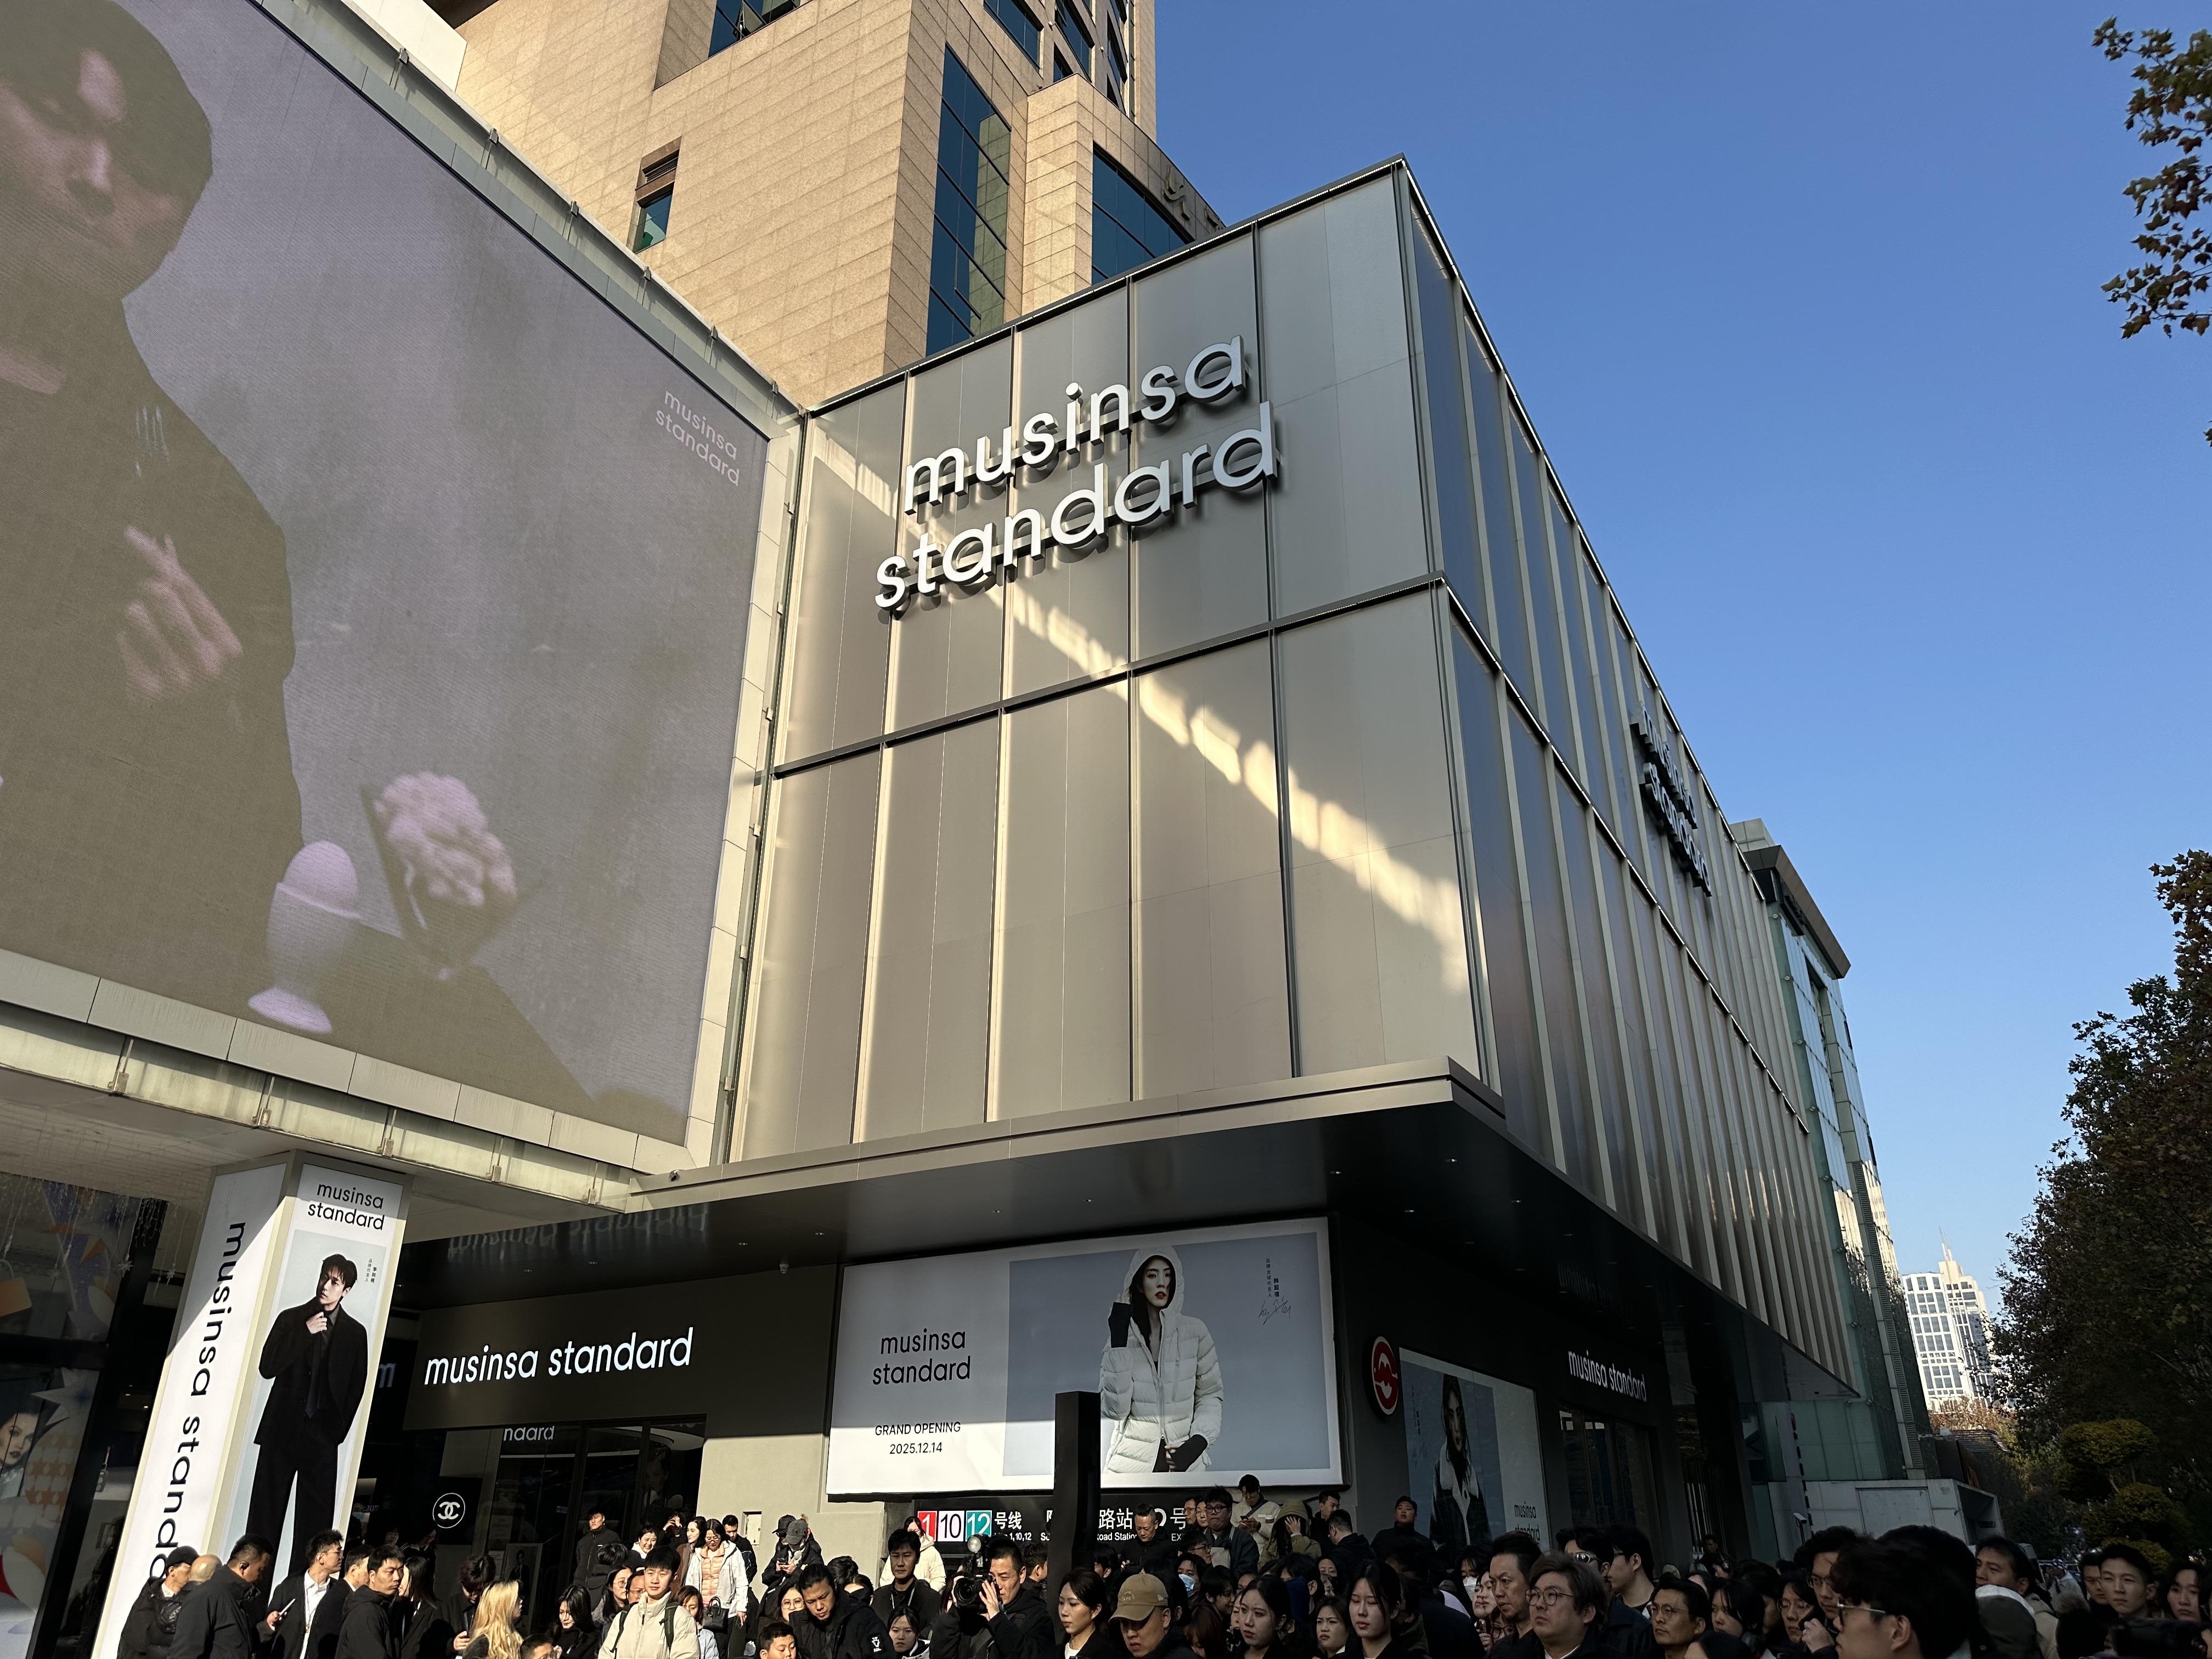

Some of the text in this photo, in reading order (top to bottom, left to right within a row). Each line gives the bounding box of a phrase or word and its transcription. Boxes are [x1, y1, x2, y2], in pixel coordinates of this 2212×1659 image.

[664, 391, 737, 460] musinsa
[904, 335, 1245, 515] musinsa
[656, 410, 740, 486] standard
[875, 402, 1279, 611] standard
[317, 1184, 383, 1209] musinsa
[308, 1203, 385, 1231] standard
[881, 1328, 966, 1354] musinsa
[424, 1345, 539, 1385] musinsa
[549, 1327, 693, 1376] standard
[872, 1356, 970, 1385] standard
[1568, 1350, 1647, 1402] musinsa standard
[150, 1222, 245, 1578] musinsa standa
[503, 1426, 555, 1442] ndard
[875, 1421, 961, 1436] GRAND OPENING
[889, 1442, 943, 1454] 2025.12.14
[1514, 1500, 1537, 1519] musinsa
[922, 1514, 931, 1537] 1
[940, 1514, 962, 1538] 10
[967, 1513, 991, 1535] 12
[994, 1511, 1022, 1530] 号线
